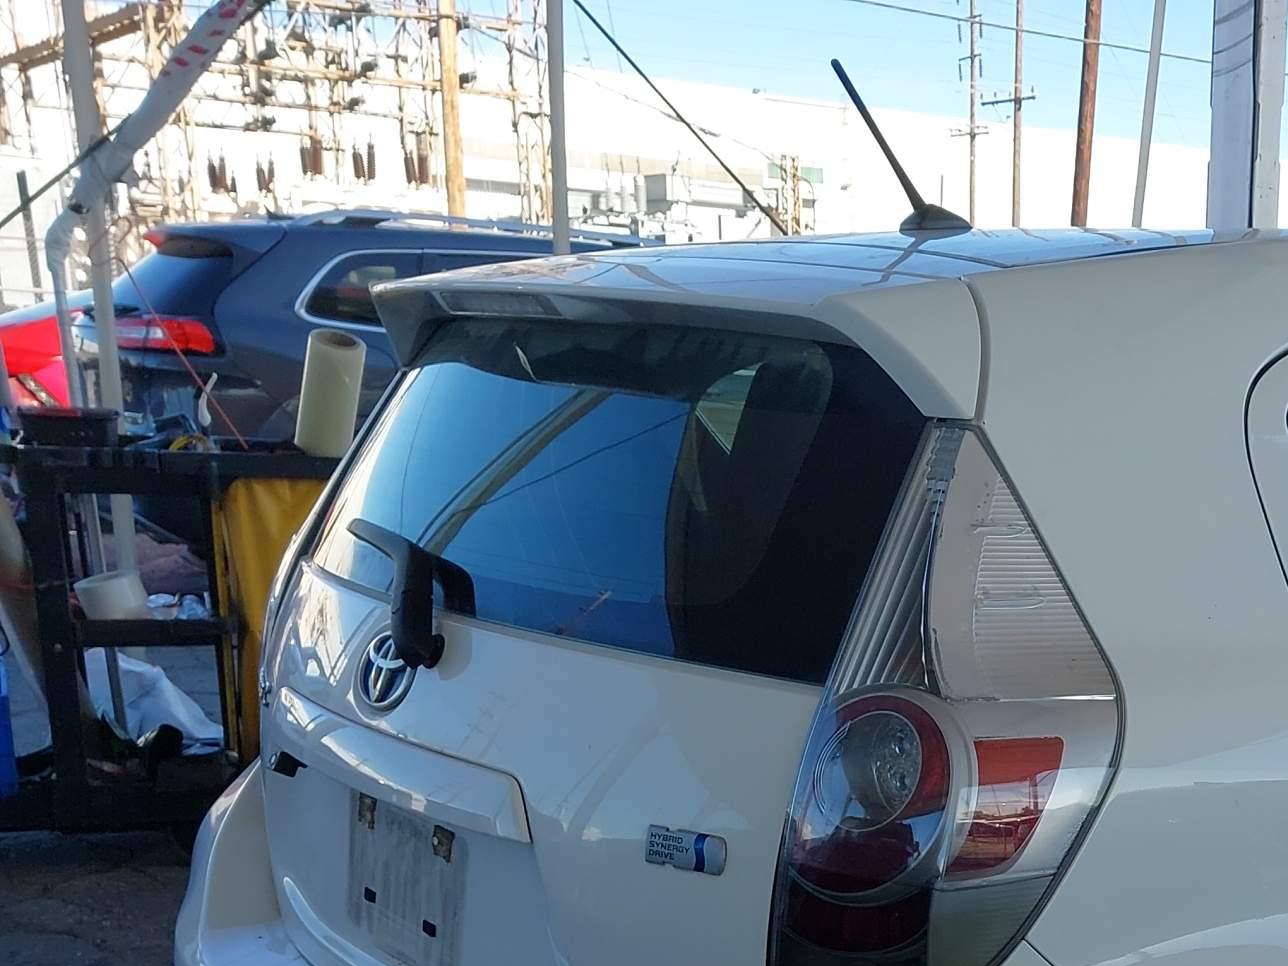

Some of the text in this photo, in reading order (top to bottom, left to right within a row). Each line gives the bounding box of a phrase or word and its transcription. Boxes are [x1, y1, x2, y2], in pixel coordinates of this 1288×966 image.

[650, 832, 684, 845] HYBRID
[648, 840, 690, 854] SYNERGY
[648, 848, 675, 861] DRIVE
